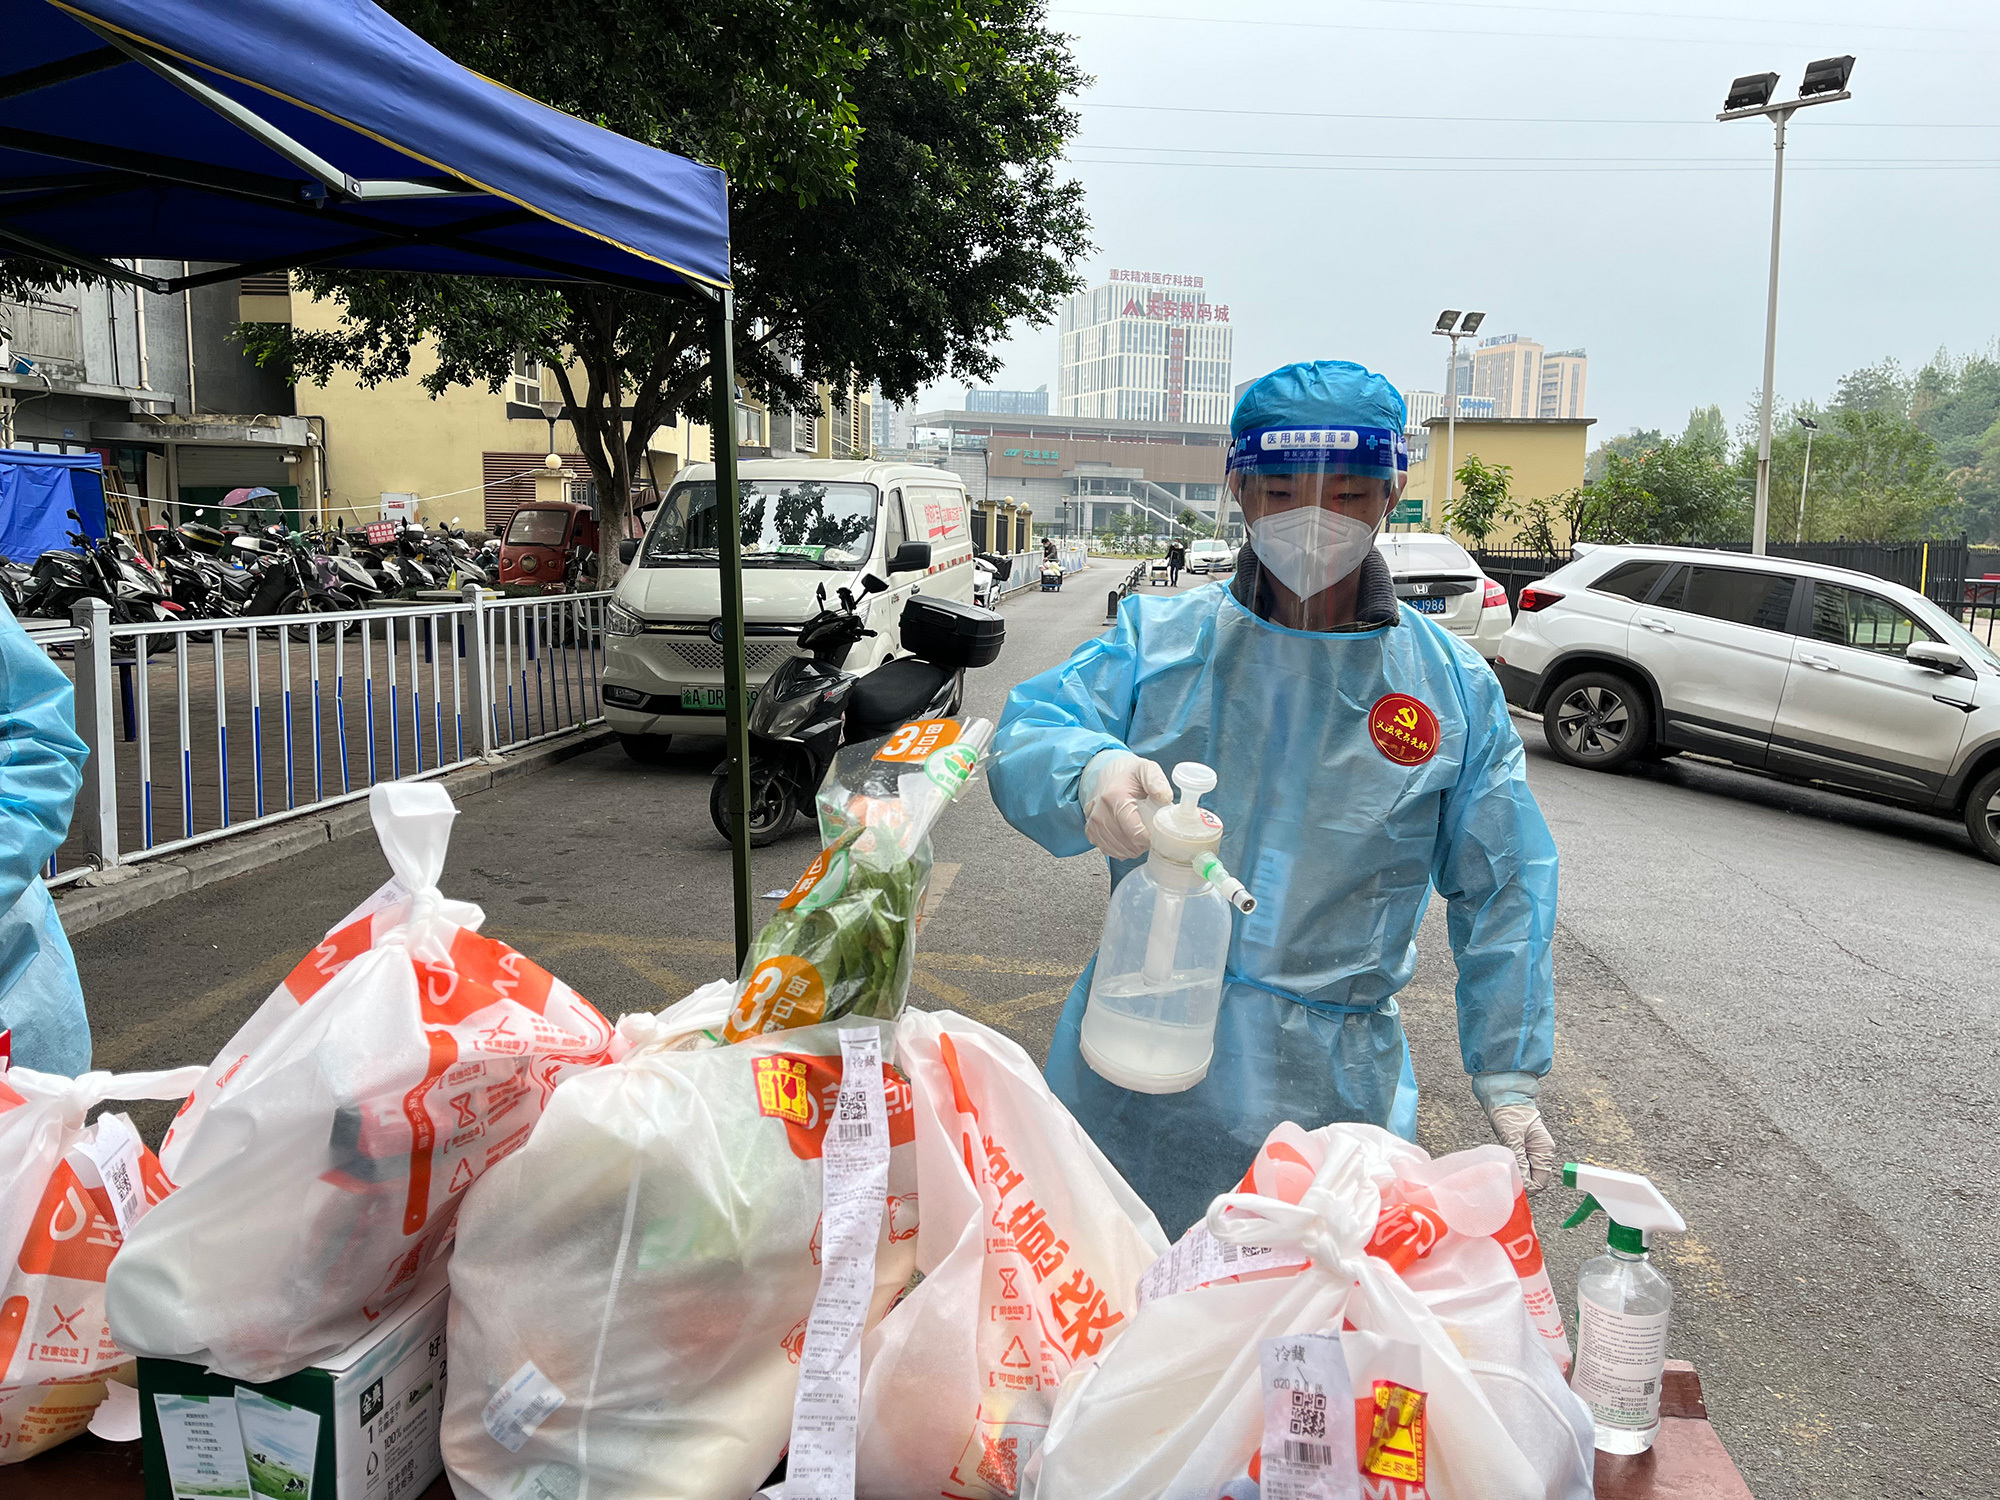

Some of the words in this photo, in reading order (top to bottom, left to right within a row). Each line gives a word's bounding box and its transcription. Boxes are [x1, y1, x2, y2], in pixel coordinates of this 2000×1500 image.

[1109, 268, 1204, 288] 重庆精准医疗科技园
[1146, 299, 1230, 322] 天安数码城
[1267, 432, 1351, 444] 医用隔离面罩
[882, 726, 919, 756] 3
[731, 967, 782, 1032] 3
[39, 1345, 79, 1358] 有害垃圾
[1275, 1345, 1307, 1364] 冷藏
[998, 1373, 1034, 1385] 可回收物
[362, 1383, 383, 1418] 金典
[384, 1427, 402, 1450] 100%
